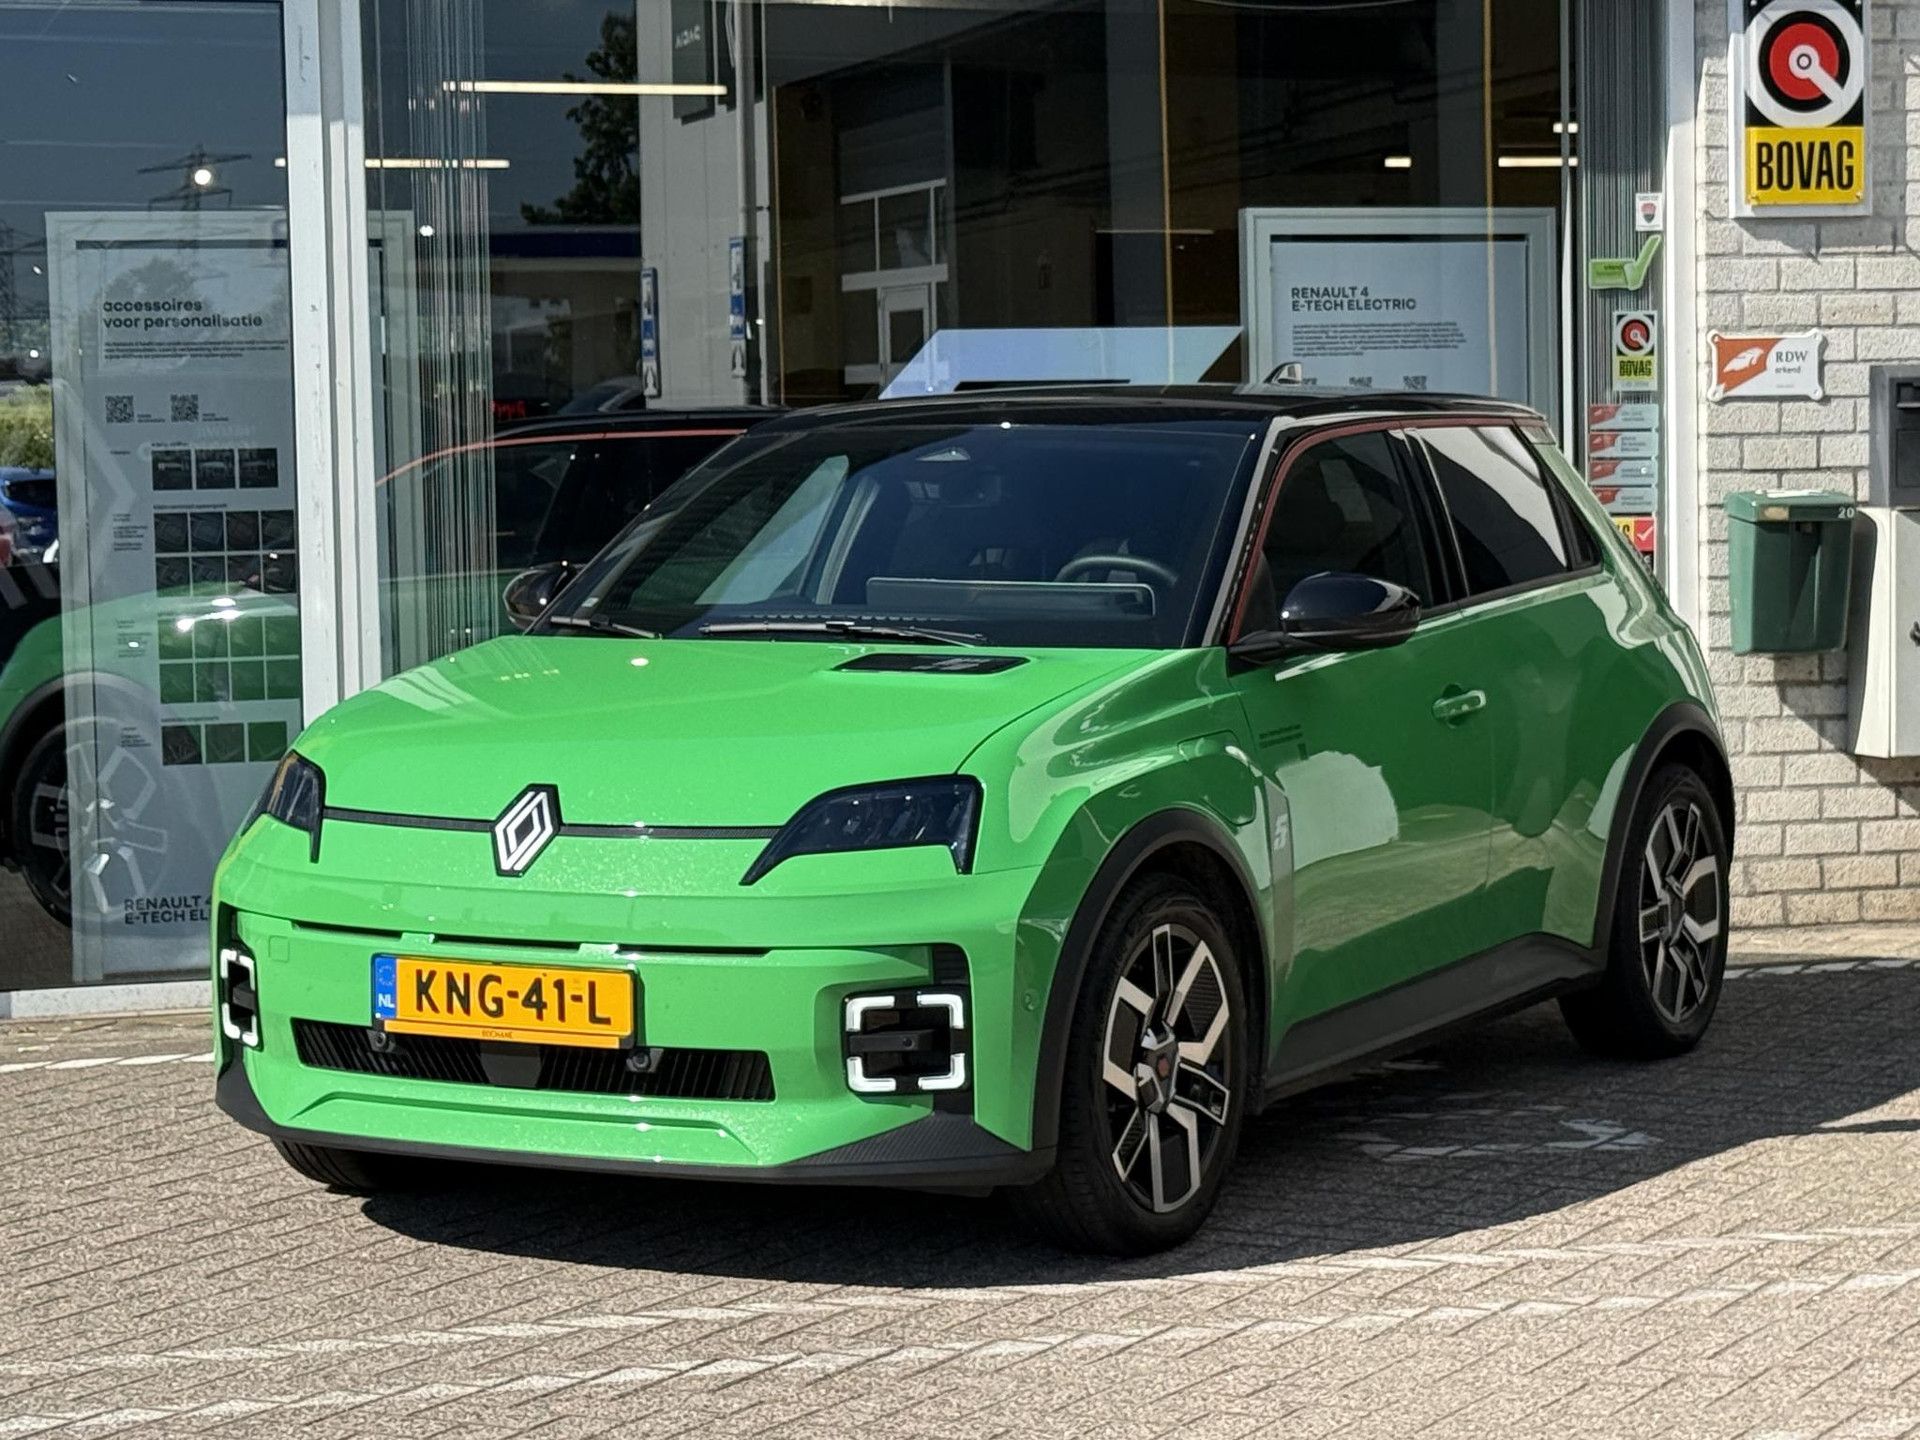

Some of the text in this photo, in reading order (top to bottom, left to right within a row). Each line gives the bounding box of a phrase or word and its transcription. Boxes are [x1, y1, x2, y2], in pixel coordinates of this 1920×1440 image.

[1756, 140, 1854, 191] BOVAG
[1291, 286, 1369, 299] RENAULT 4
[103, 299, 202, 312] accessoires
[1291, 298, 1416, 311] E-TECH ELECTRIC
[104, 314, 263, 331] voor personalisatie
[1775, 350, 1808, 363] RDW
[1619, 360, 1652, 377] BOVAG
[1838, 507, 1855, 519] 20
[124, 895, 201, 911] RENAULT
[124, 910, 186, 925] E-TECH
[378, 993, 395, 1009] NL
[415, 968, 612, 1026] KNG-41-L
